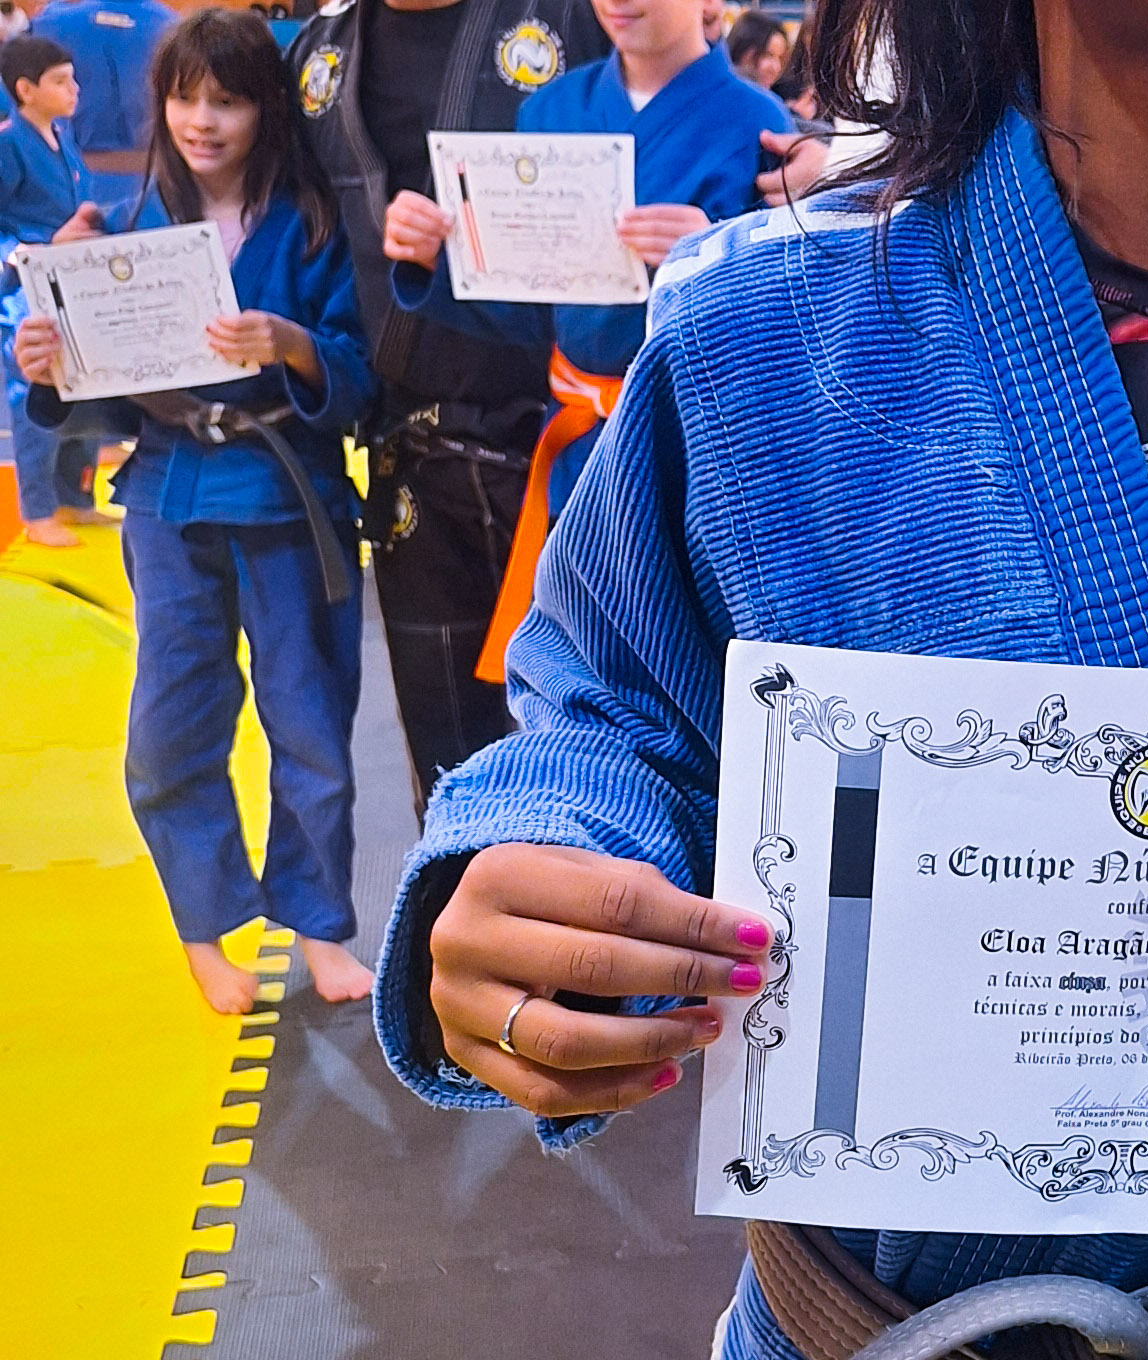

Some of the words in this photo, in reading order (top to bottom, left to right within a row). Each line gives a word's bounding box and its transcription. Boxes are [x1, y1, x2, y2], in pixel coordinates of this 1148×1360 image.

[1114, 773, 1138, 830] EQUIPE
[948, 845, 1075, 884] Equipe
[980, 928, 1046, 955] Eloa
[987, 974, 998, 987] a
[1004, 971, 1053, 988] faixa
[1119, 975, 1148, 992] por
[973, 996, 1049, 1017] técnicas
[1054, 1003, 1064, 1017] e
[1070, 1001, 1141, 1019] morais,
[1020, 1026, 1114, 1047] princípios
[1120, 1028, 1140, 1045] do
[1014, 1052, 1071, 1065] Ribeirão
[1075, 1053, 1117, 1067] Preto,
[1055, 1110, 1076, 1118] Prof.
[1078, 1110, 1124, 1118] Alexandre
[1121, 1121, 1142, 1129] grau
